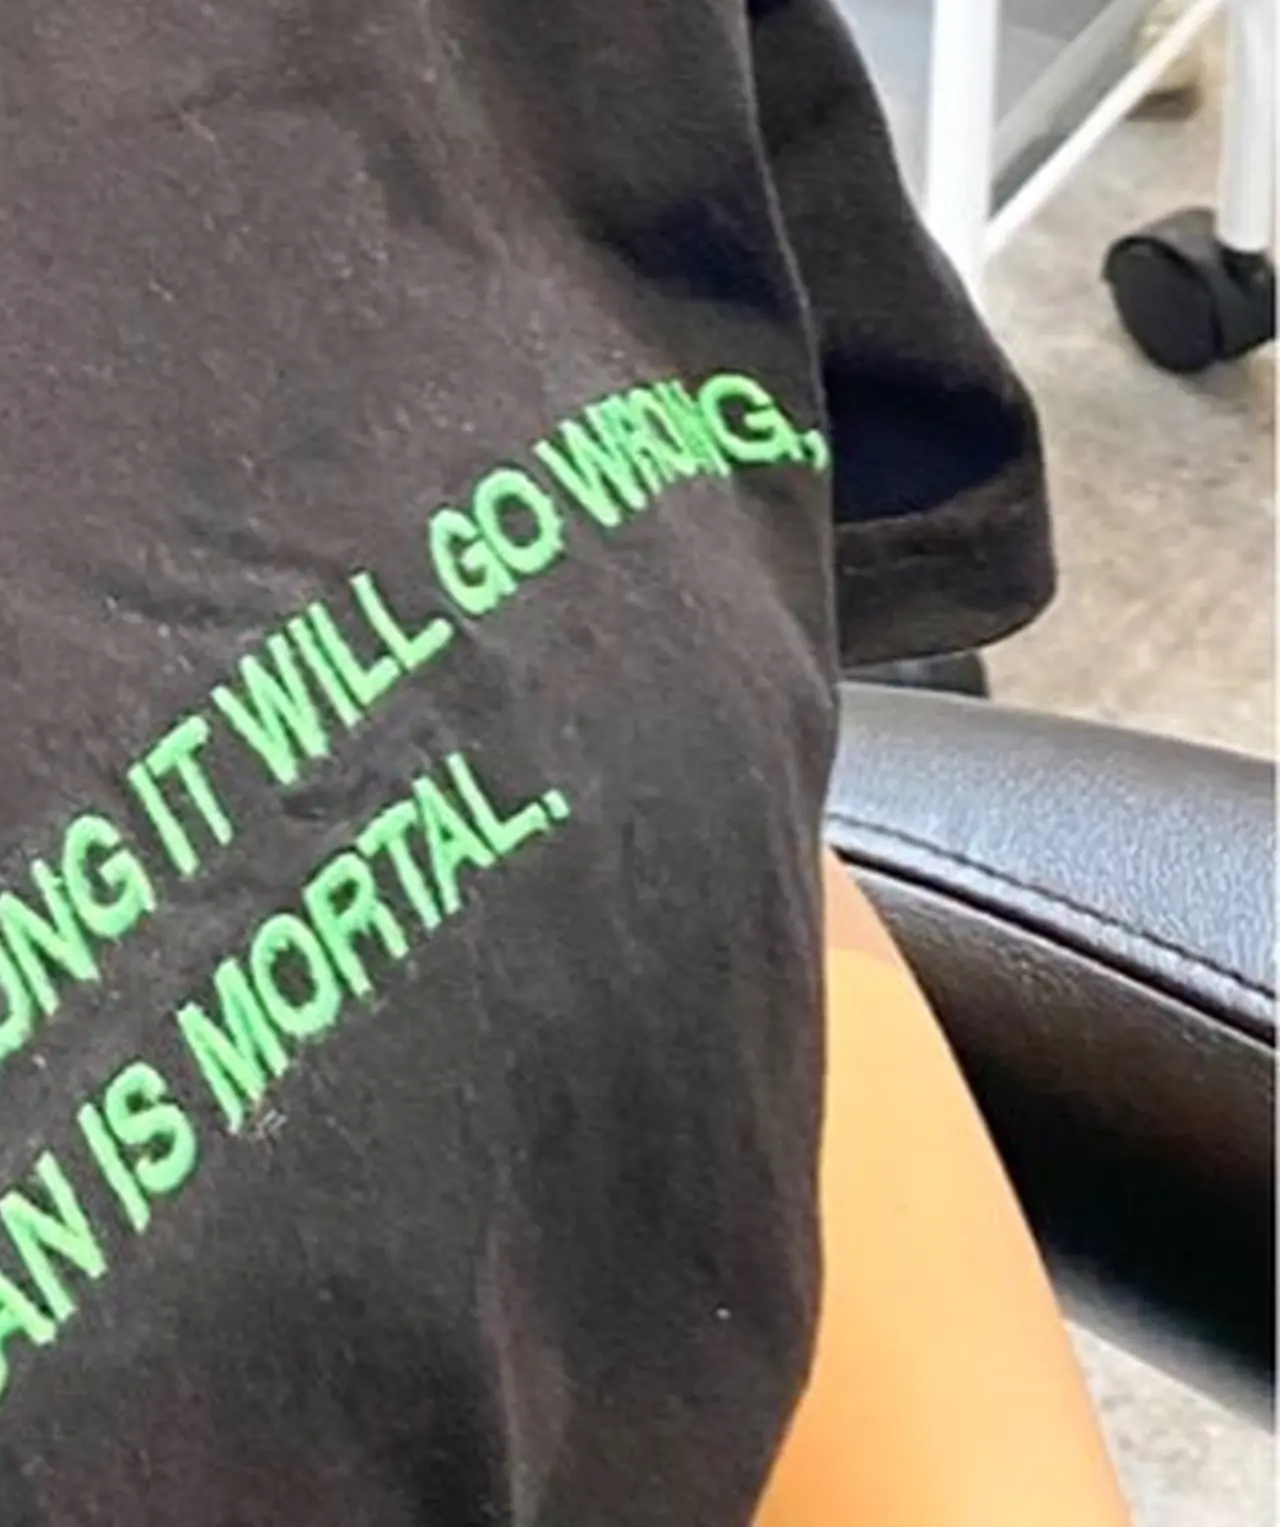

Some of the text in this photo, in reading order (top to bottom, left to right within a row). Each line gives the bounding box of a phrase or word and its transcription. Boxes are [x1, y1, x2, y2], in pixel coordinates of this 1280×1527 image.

[126, 713, 234, 877] IT
[211, 570, 454, 785] WILL
[429, 468, 564, 616] GO
[78, 1061, 198, 1233] IS
[176, 751, 571, 1134] MORTAL.
